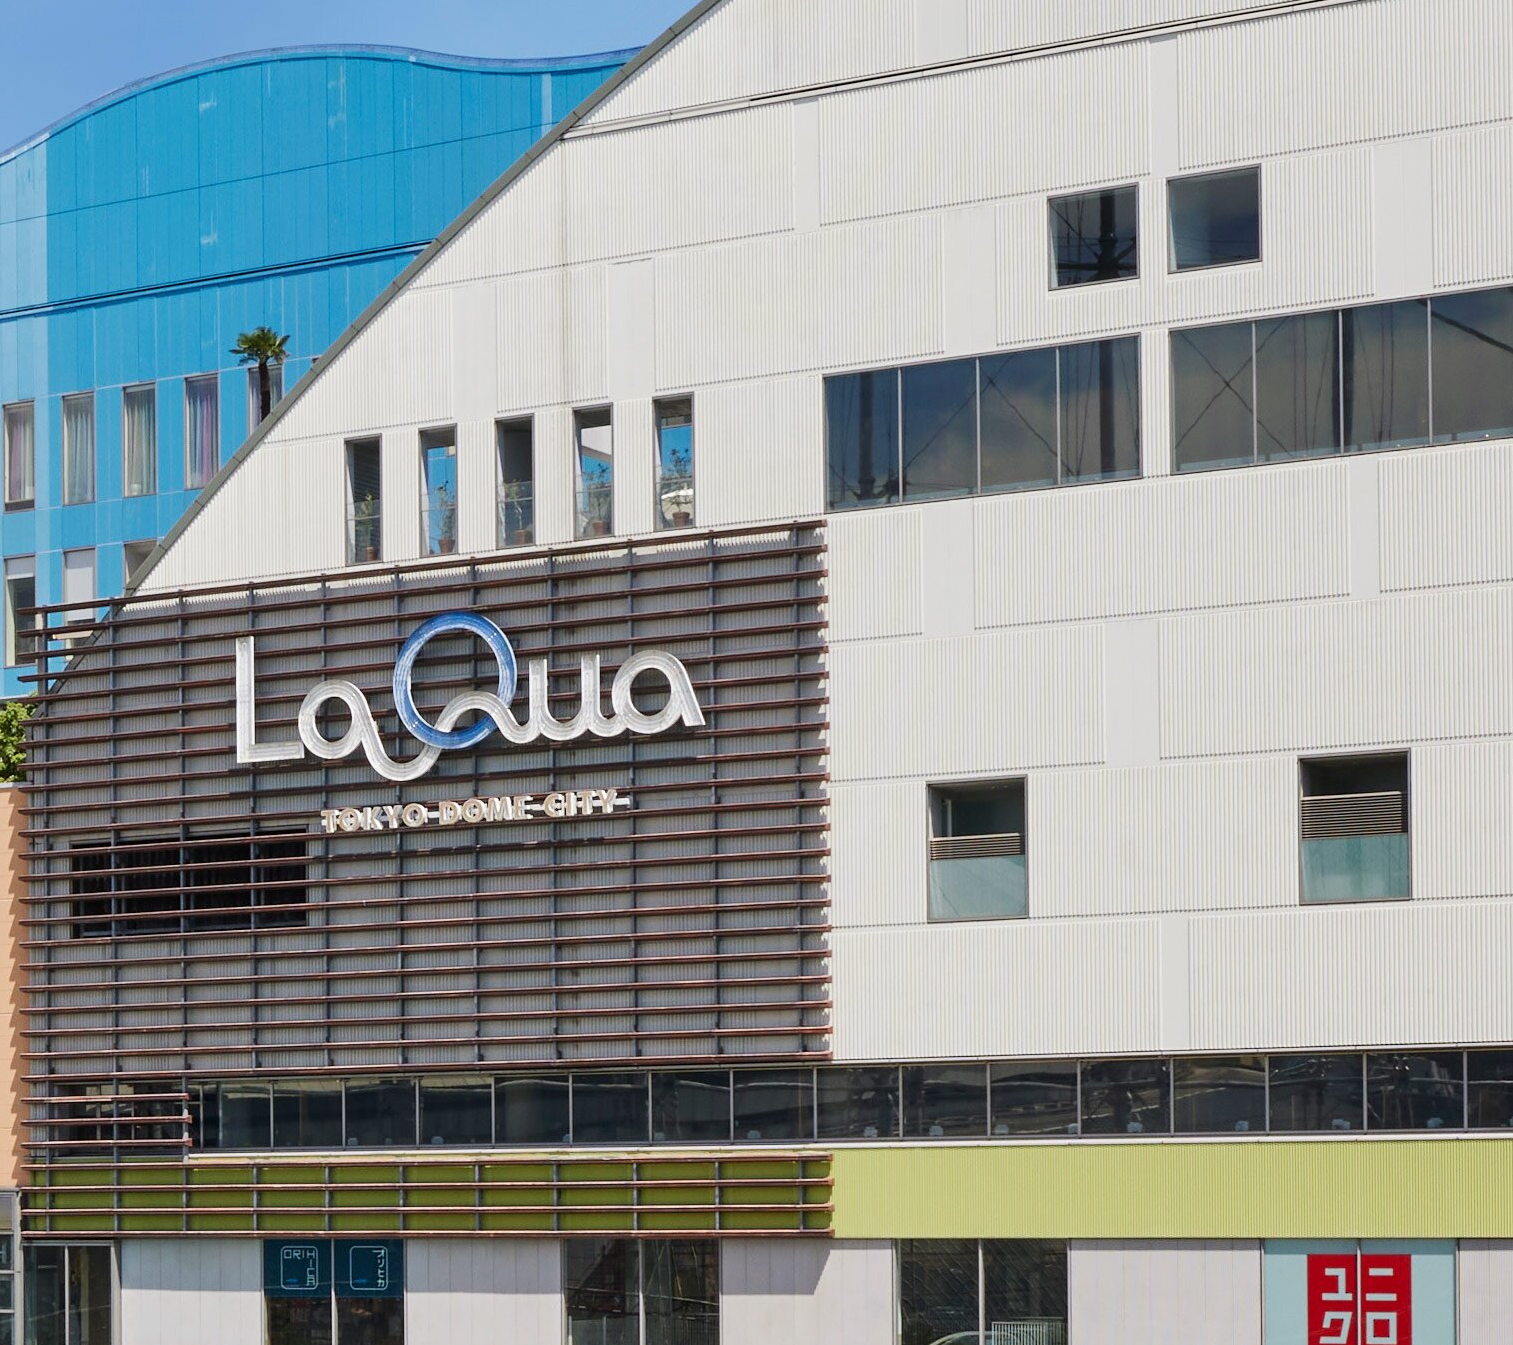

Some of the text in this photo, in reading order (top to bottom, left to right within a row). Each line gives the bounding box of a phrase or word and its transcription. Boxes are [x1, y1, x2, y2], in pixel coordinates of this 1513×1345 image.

[235, 611, 706, 782] LaQua
[321, 789, 618, 834] TOKYO DOME CITY
[1322, 1266, 1398, 1302] ユニ
